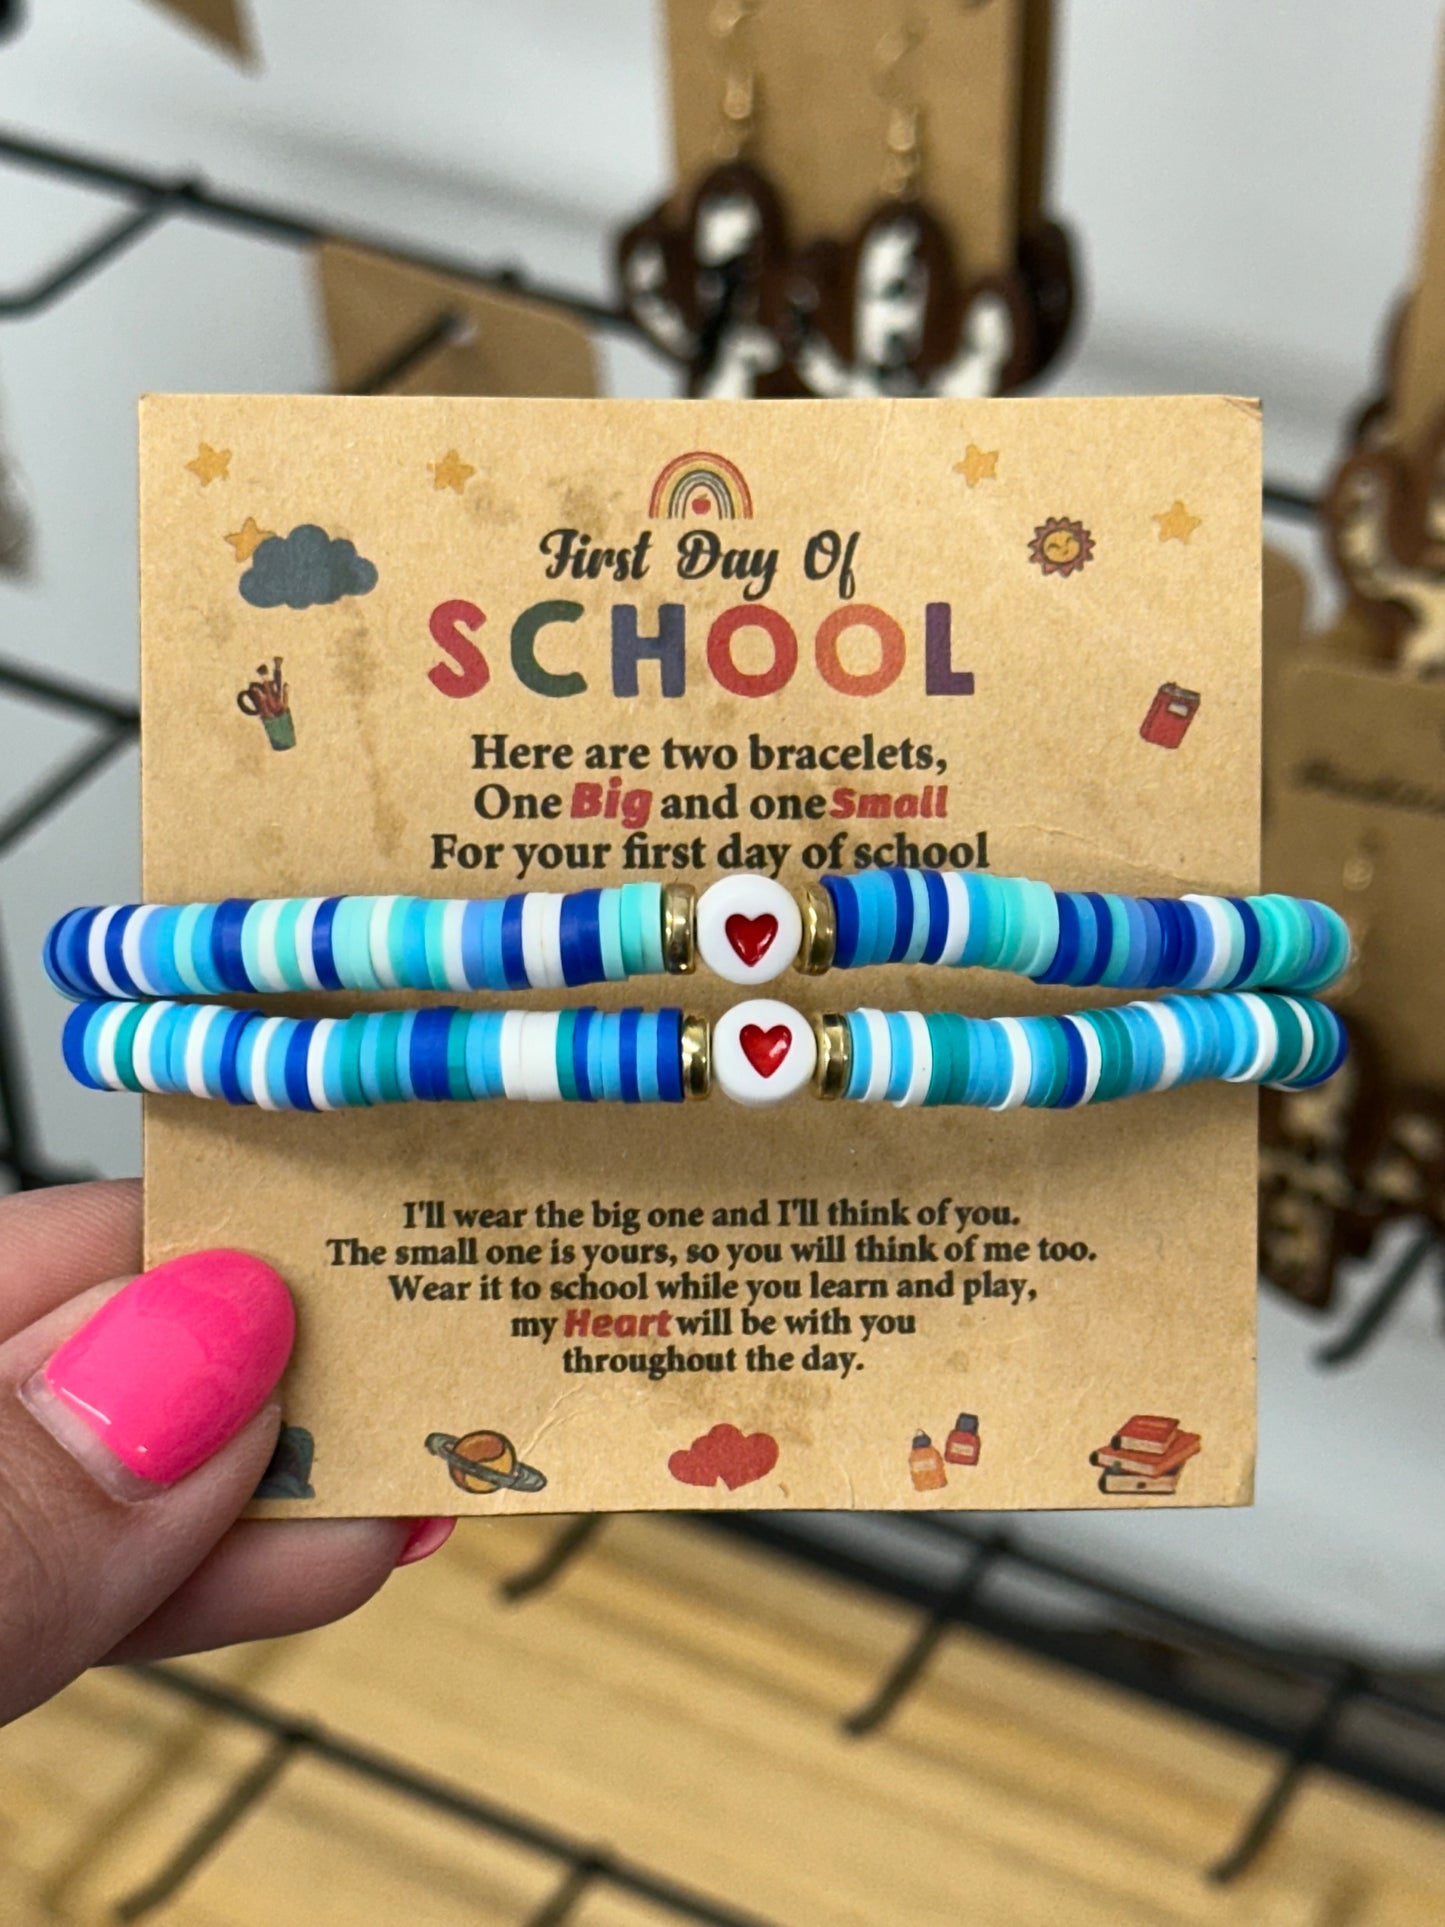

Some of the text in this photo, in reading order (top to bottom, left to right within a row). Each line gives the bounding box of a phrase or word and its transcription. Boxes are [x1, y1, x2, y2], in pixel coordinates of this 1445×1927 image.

[539, 528, 861, 602] First Day Of
[427, 597, 975, 698] SCHOOL
[471, 733, 947, 775] Here are two bracelets,
[474, 776, 948, 829] One Big and one Small
[430, 831, 991, 880] For your first day of school
[403, 1198, 1020, 1235] I'll wear the big one and I'll think of you.
[326, 1234, 1096, 1274] The small one is yours, so you will think of me too.
[388, 1272, 1037, 1306] Wear it to school while you learn and play,
[511, 1307, 916, 1343] my Heart will be with you
[562, 1343, 864, 1382] throughout the day.
